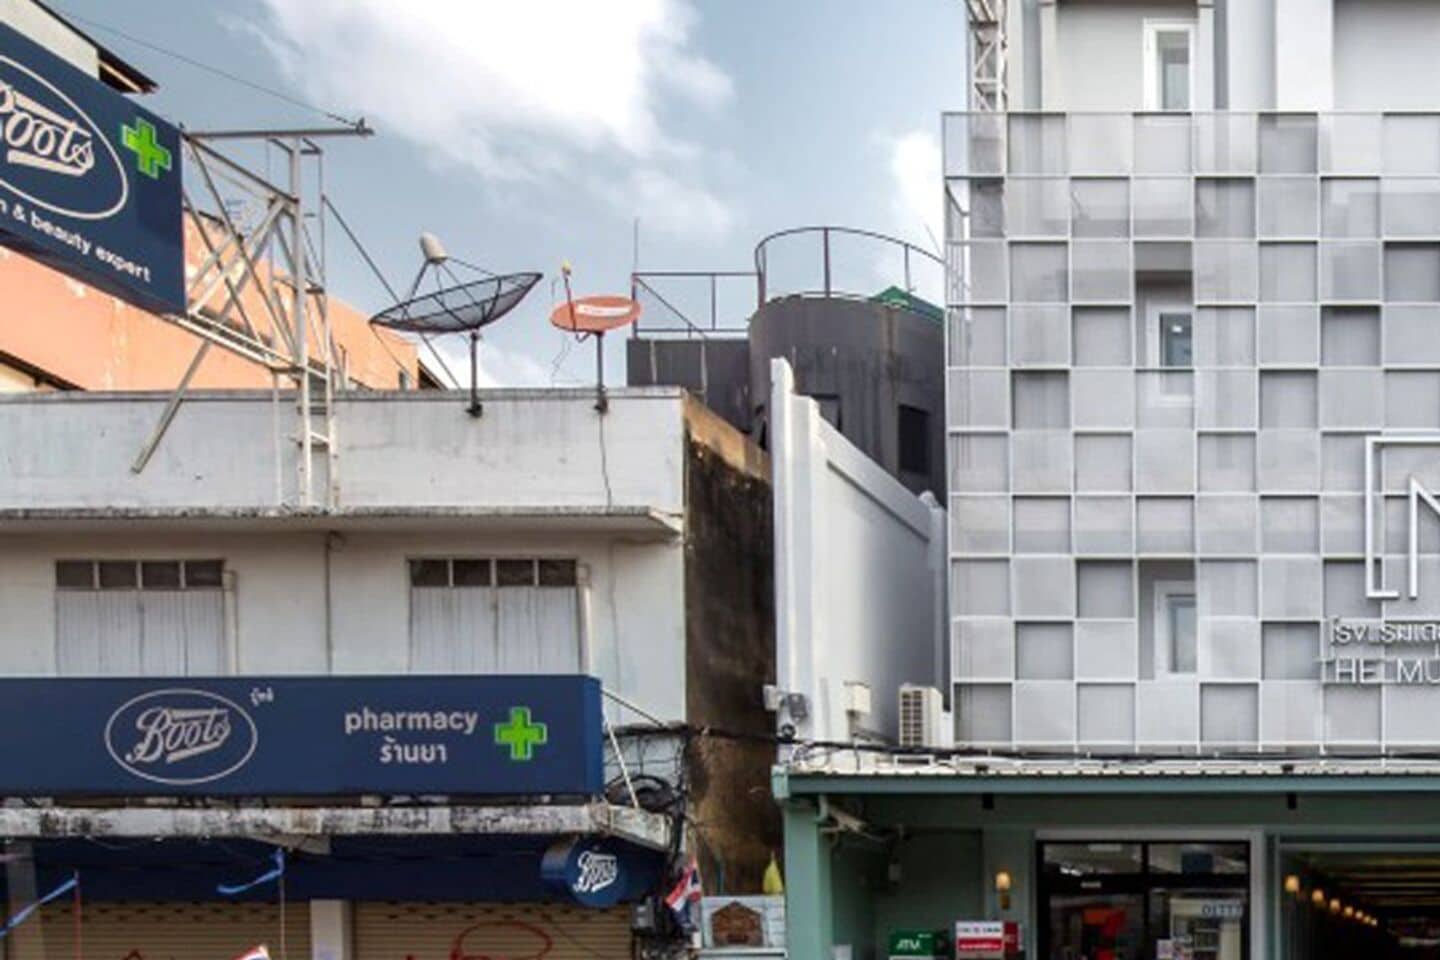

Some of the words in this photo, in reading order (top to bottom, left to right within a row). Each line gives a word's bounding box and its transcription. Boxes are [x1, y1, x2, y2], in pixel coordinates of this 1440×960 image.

[30, 211, 91, 255] beauty
[95, 246, 150, 282] expert
[1314, 655, 1377, 684] THE
[125, 706, 231, 763] Boots
[344, 706, 479, 735] pharmacy
[379, 735, 447, 763] ร้านยา
